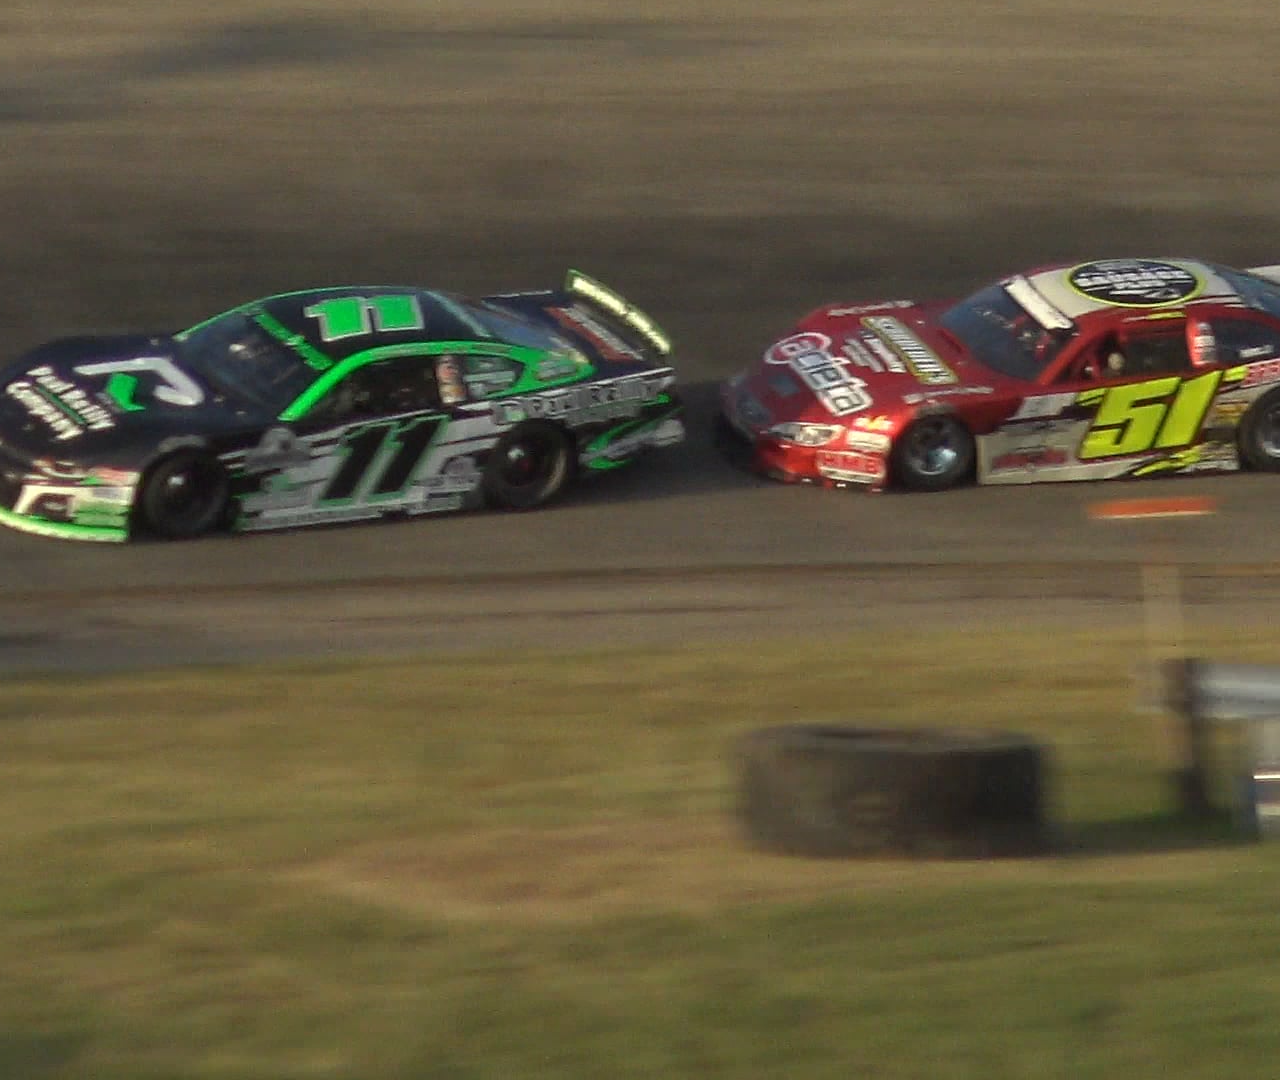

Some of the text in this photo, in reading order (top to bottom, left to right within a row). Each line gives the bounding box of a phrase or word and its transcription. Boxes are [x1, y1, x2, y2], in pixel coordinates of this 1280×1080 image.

[303, 295, 424, 342] 11
[317, 415, 447, 504] 11
[1078, 370, 1222, 460] 51
